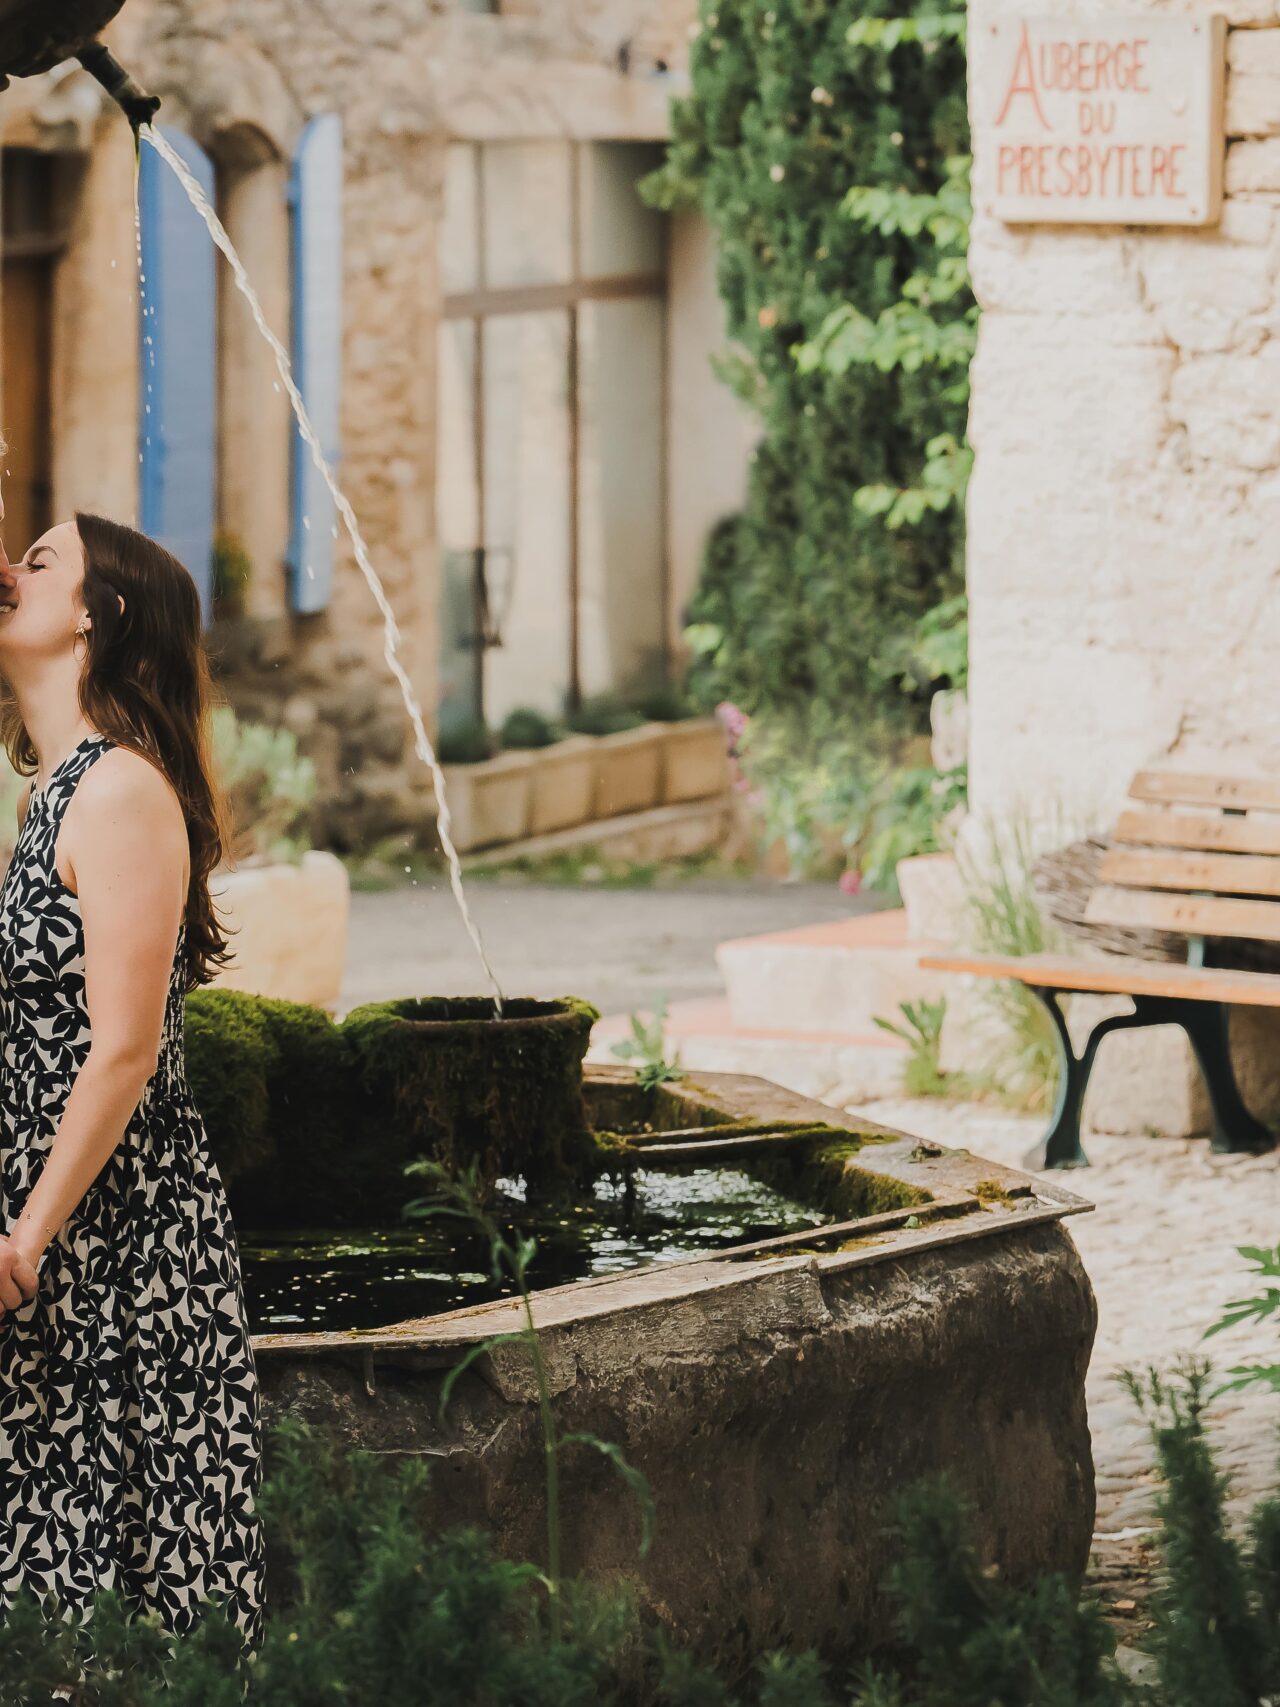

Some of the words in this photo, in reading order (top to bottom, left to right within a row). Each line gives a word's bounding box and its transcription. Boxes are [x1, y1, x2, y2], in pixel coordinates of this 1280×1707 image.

[995, 19, 1150, 130] AUBERGE
[1078, 102, 1116, 135] DU
[998, 145, 1185, 197] PRESBYTERE
